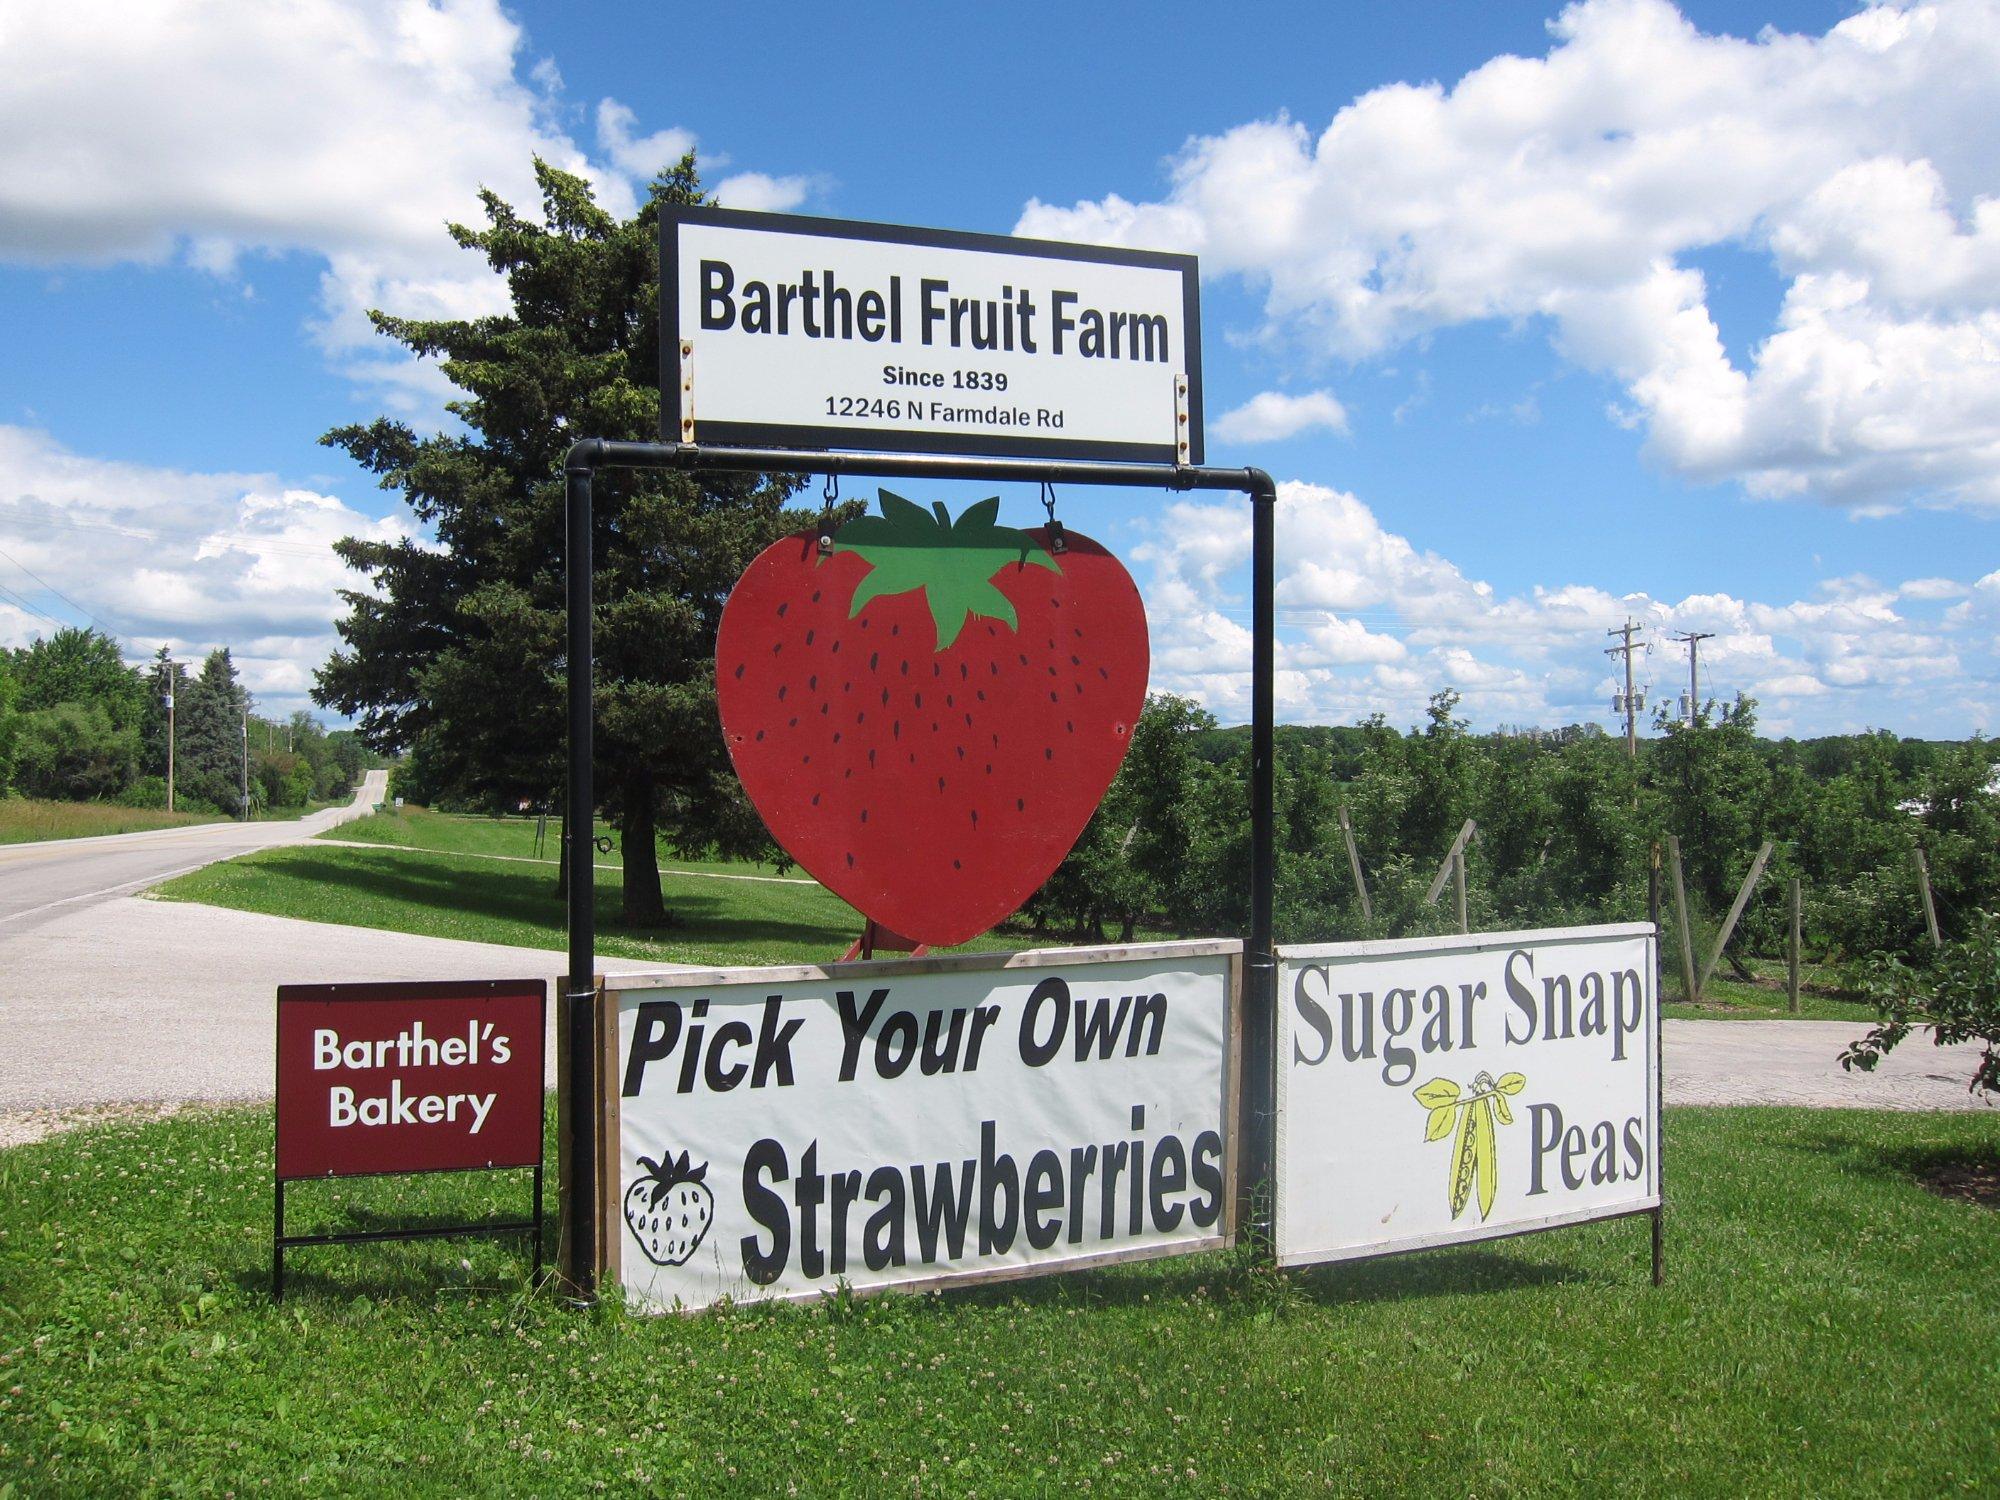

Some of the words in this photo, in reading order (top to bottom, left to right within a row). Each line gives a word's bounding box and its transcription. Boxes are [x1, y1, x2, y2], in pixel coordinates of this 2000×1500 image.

[700, 259, 901, 343] Barthel
[919, 278, 1037, 355] Fruit
[1051, 290, 1169, 363] Farm
[825, 396, 900, 419] 12246
[907, 401, 922, 421] N
[930, 402, 1030, 426] Farmdale
[1037, 409, 1064, 429] Rd
[882, 365, 945, 389] Since
[952, 370, 1008, 392] 1839
[314, 1020, 511, 1069] Barthel's
[622, 995, 804, 1097] Pick
[835, 988, 1000, 1082] Your
[1019, 977, 1167, 1068] Own
[1294, 964, 1487, 1086] Sugar
[1504, 949, 1642, 1061] Snap
[330, 1079, 497, 1133] Bakery
[1525, 1103, 1644, 1196] Peas
[740, 1105, 1223, 1284] Strawberries
